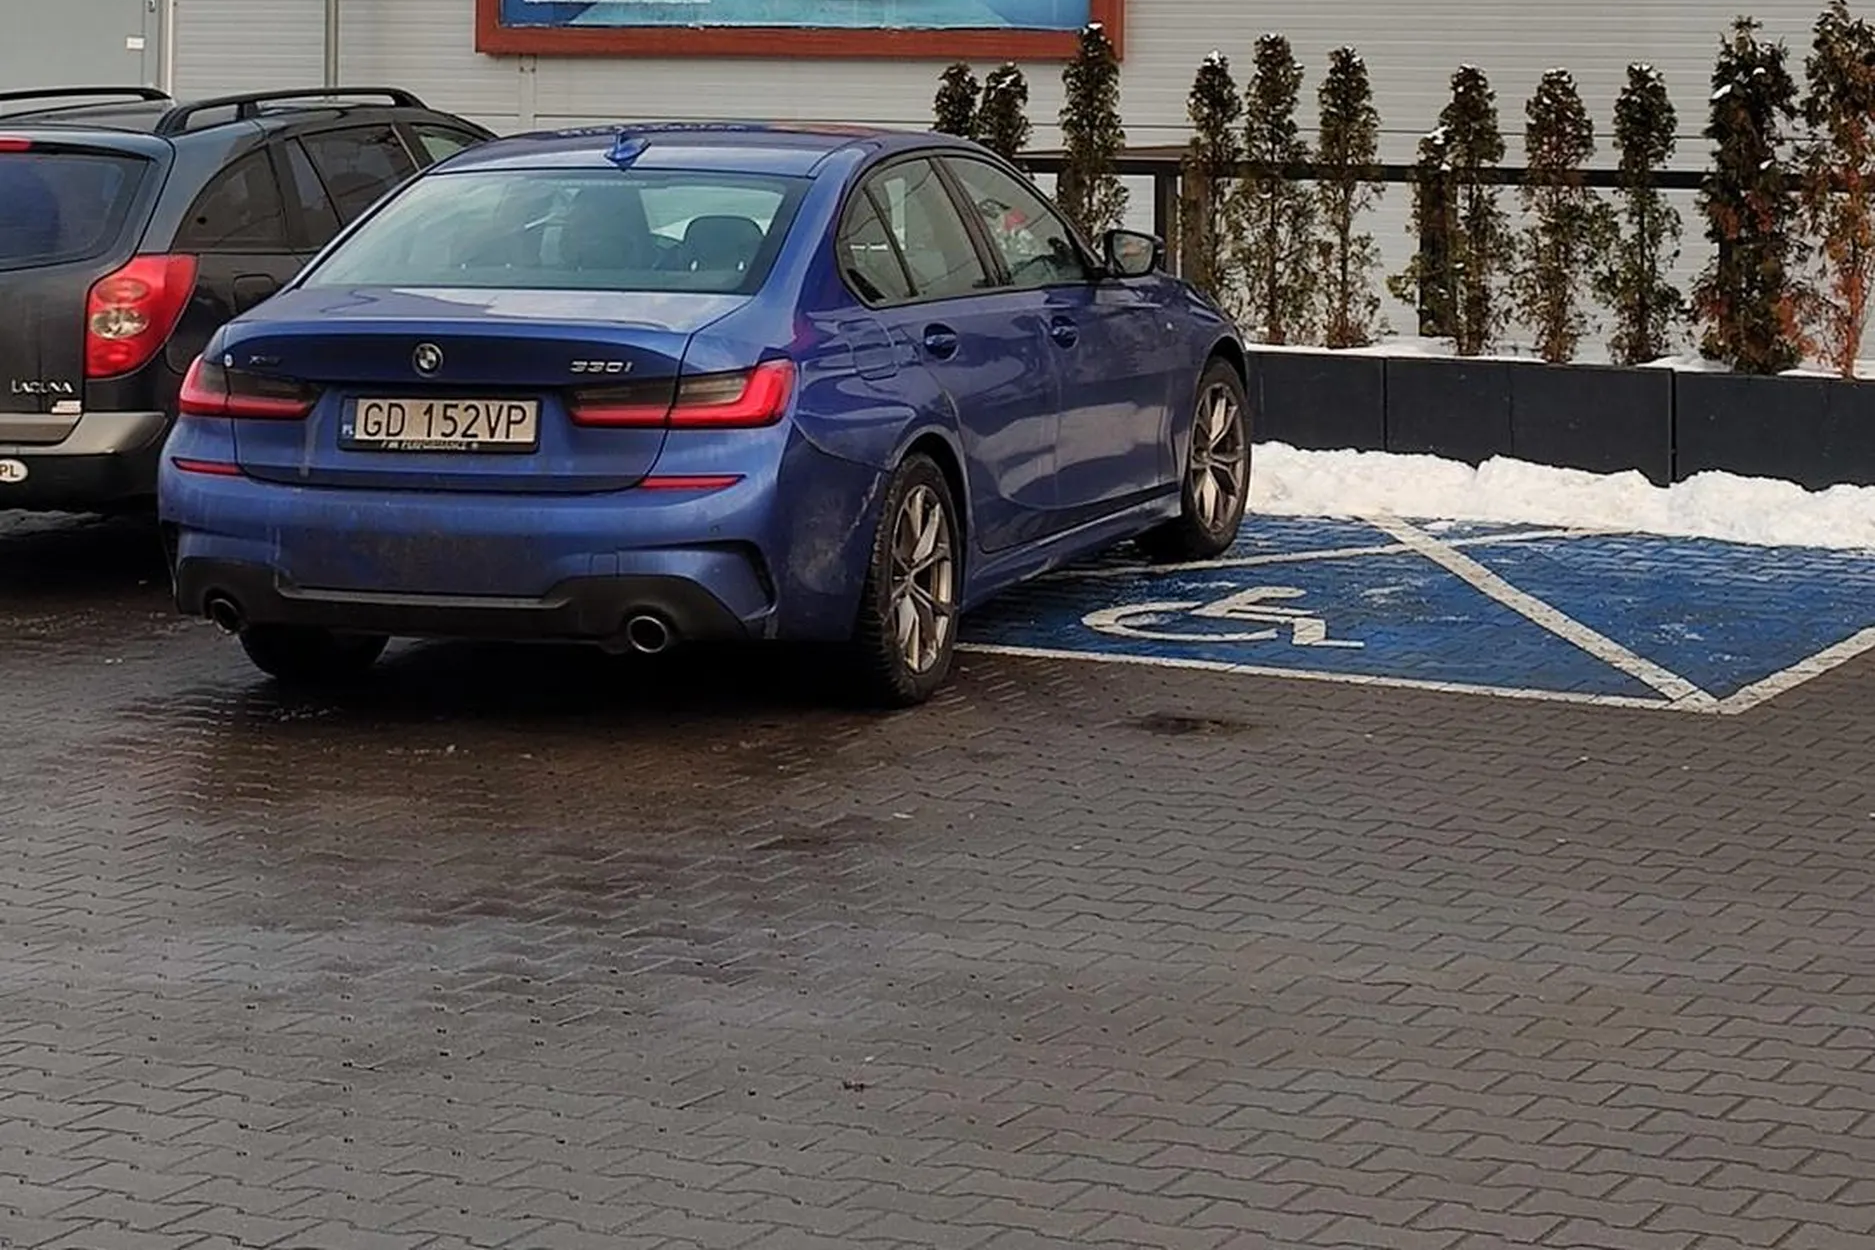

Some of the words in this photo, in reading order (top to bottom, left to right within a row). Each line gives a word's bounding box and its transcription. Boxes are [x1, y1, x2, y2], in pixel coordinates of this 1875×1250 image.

[569, 360, 633, 373] 330i
[363, 403, 406, 438] GD
[423, 403, 527, 439] 152VP
[0, 464, 19, 478] PL
